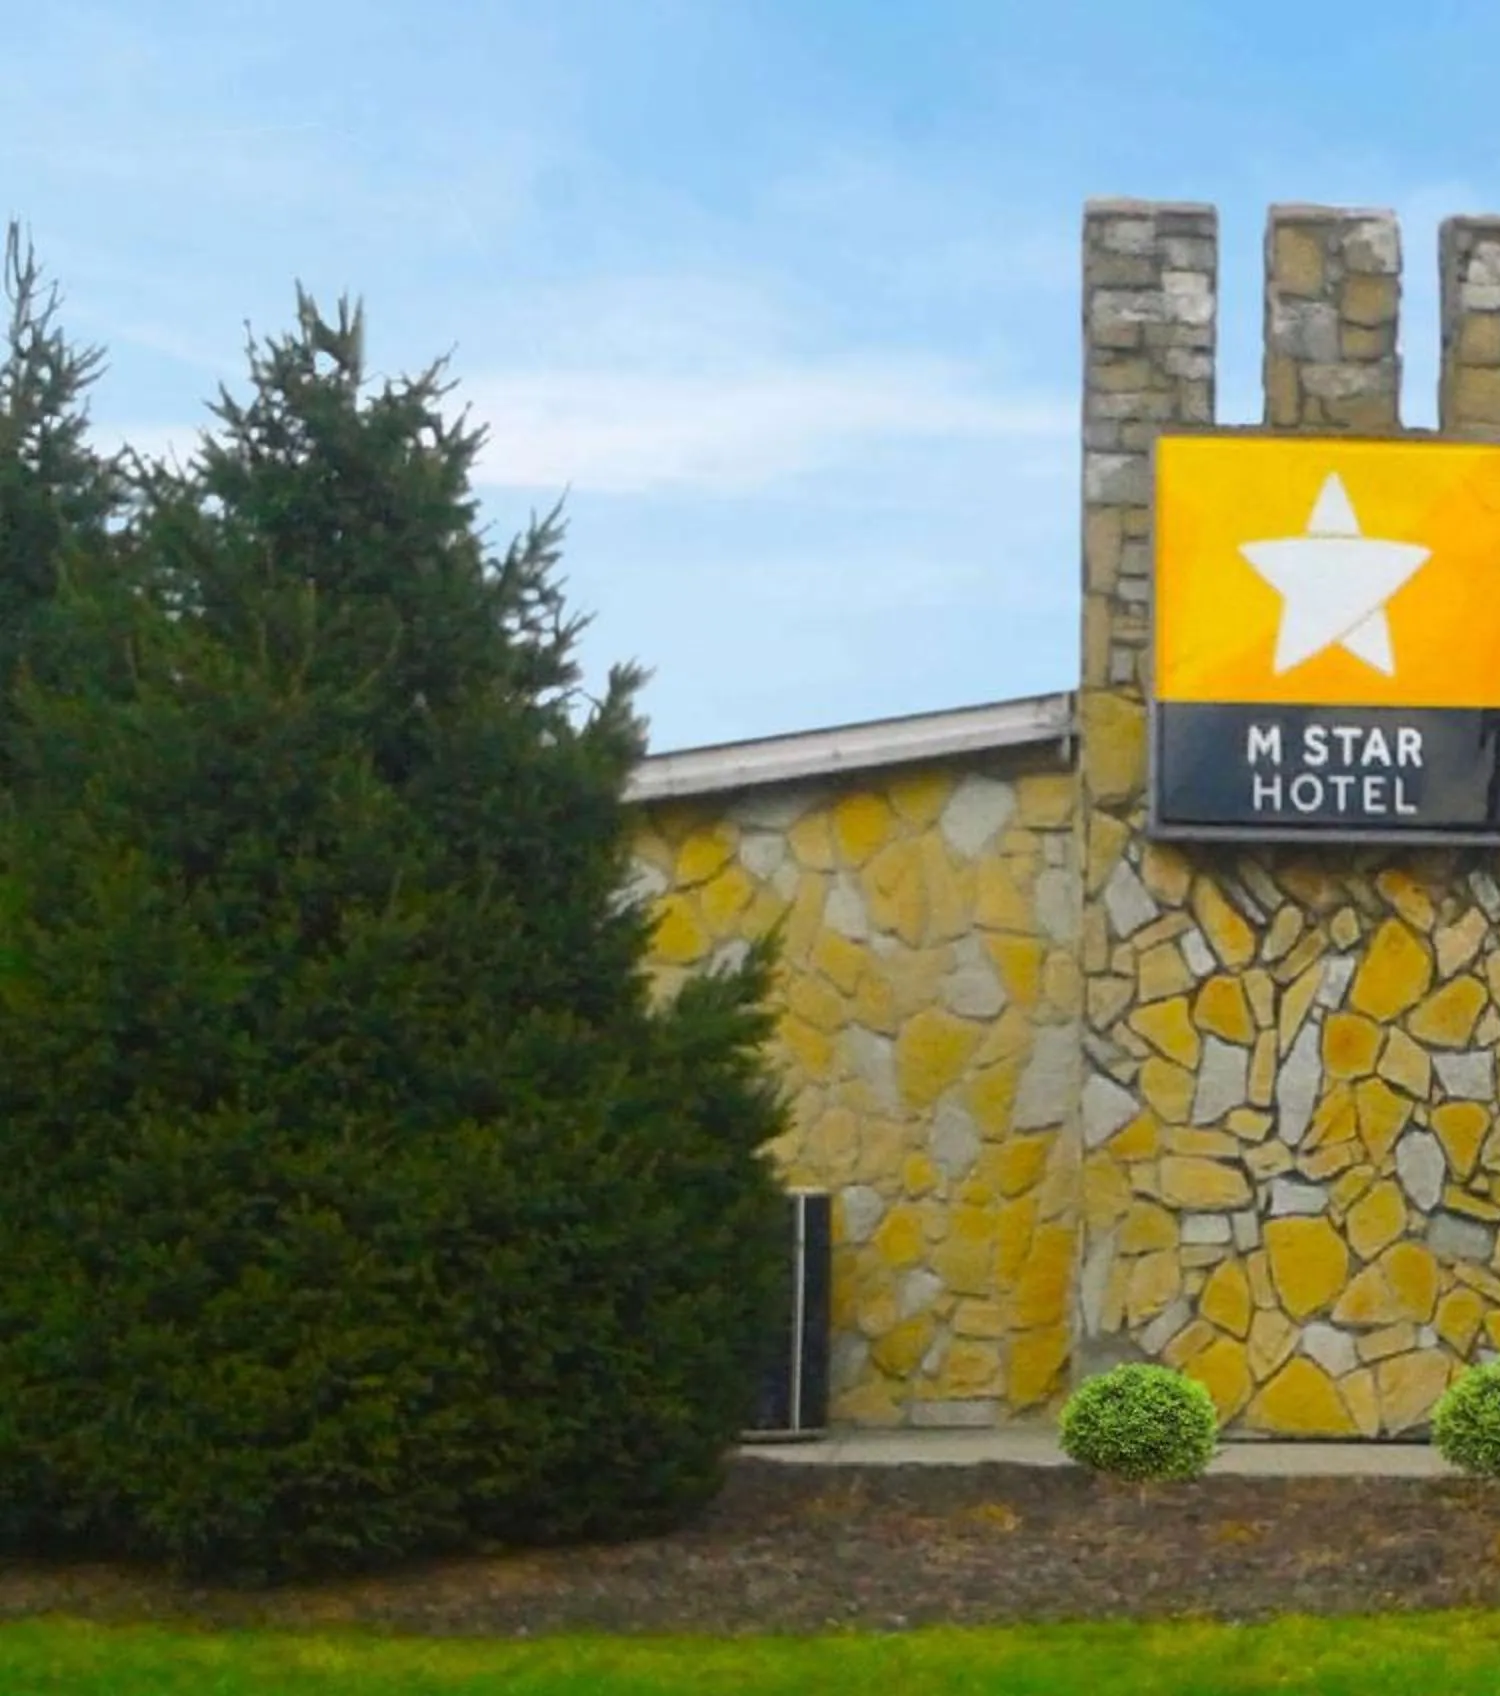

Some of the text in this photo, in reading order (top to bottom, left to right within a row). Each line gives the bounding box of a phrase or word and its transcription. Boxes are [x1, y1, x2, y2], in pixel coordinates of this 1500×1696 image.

[1246, 724, 1424, 768] M STAR
[1252, 774, 1418, 814] HOTEL
